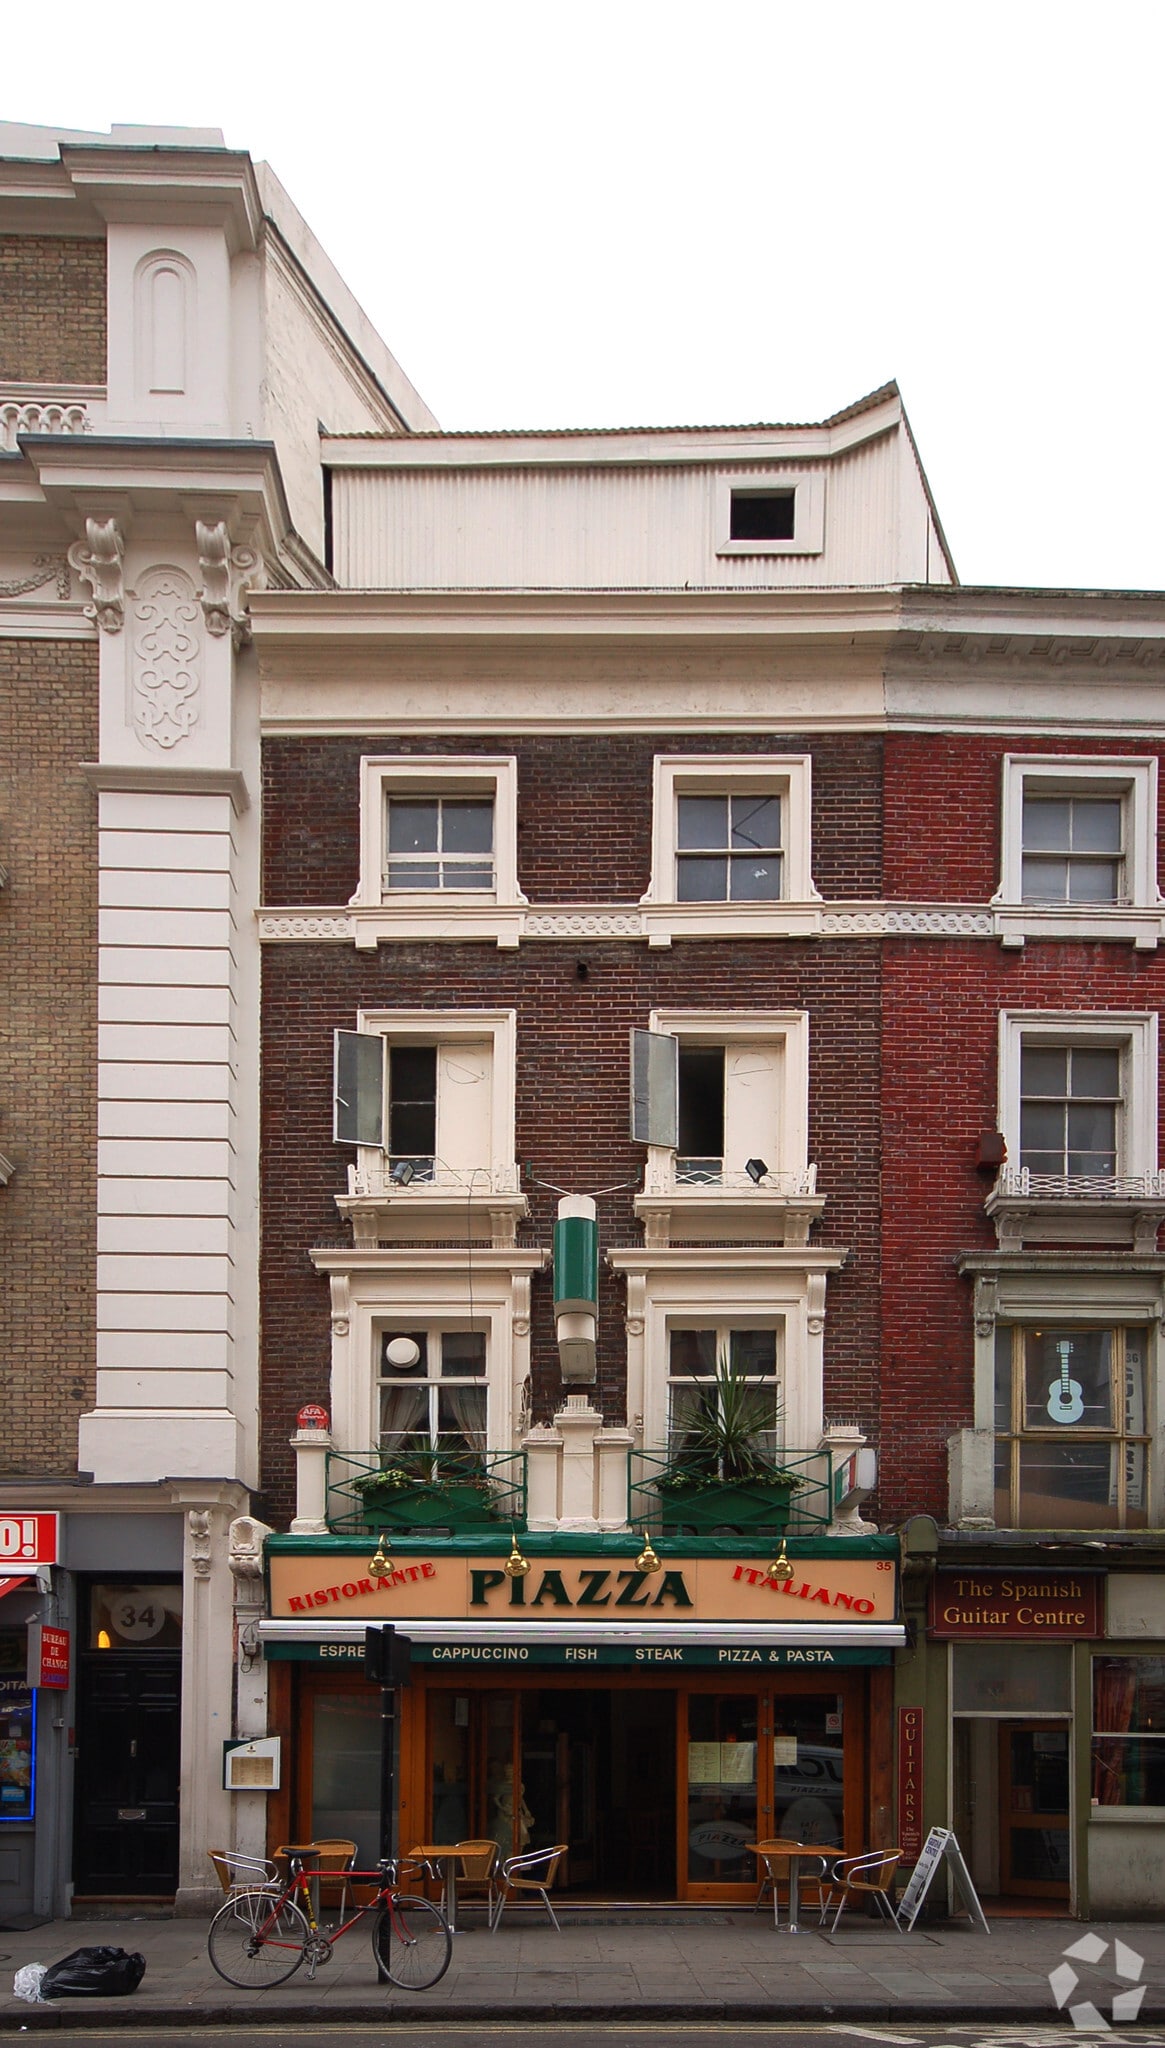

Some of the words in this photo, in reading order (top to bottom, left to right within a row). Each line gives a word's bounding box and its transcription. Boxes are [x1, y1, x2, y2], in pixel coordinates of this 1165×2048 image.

[1126, 1352, 1139, 1363] 36
[876, 1561, 892, 1572] 35
[288, 1562, 437, 1612] RISTORANTE
[470, 1569, 694, 1607] PIAZZA
[731, 1565, 875, 1615] ITALIANO
[954, 1579, 992, 1598] The
[1001, 1579, 1082, 1602] Spanish
[120, 1606, 156, 1628] 34
[943, 1606, 1010, 1625] Guitar
[1016, 1606, 1086, 1625] Centre
[42, 1632, 67, 1648] BUREAU
[50, 1646, 59, 1657] DE
[432, 1647, 529, 1660] CAPPUCCINO
[565, 1647, 597, 1660] FISH
[635, 1648, 684, 1661] STEAK
[718, 1649, 762, 1662] PIZZA
[768, 1650, 780, 1662] &
[786, 1650, 834, 1662] PASTA
[42, 1656, 69, 1670] CHANGE
[905, 1712, 917, 1822] GUITARS
